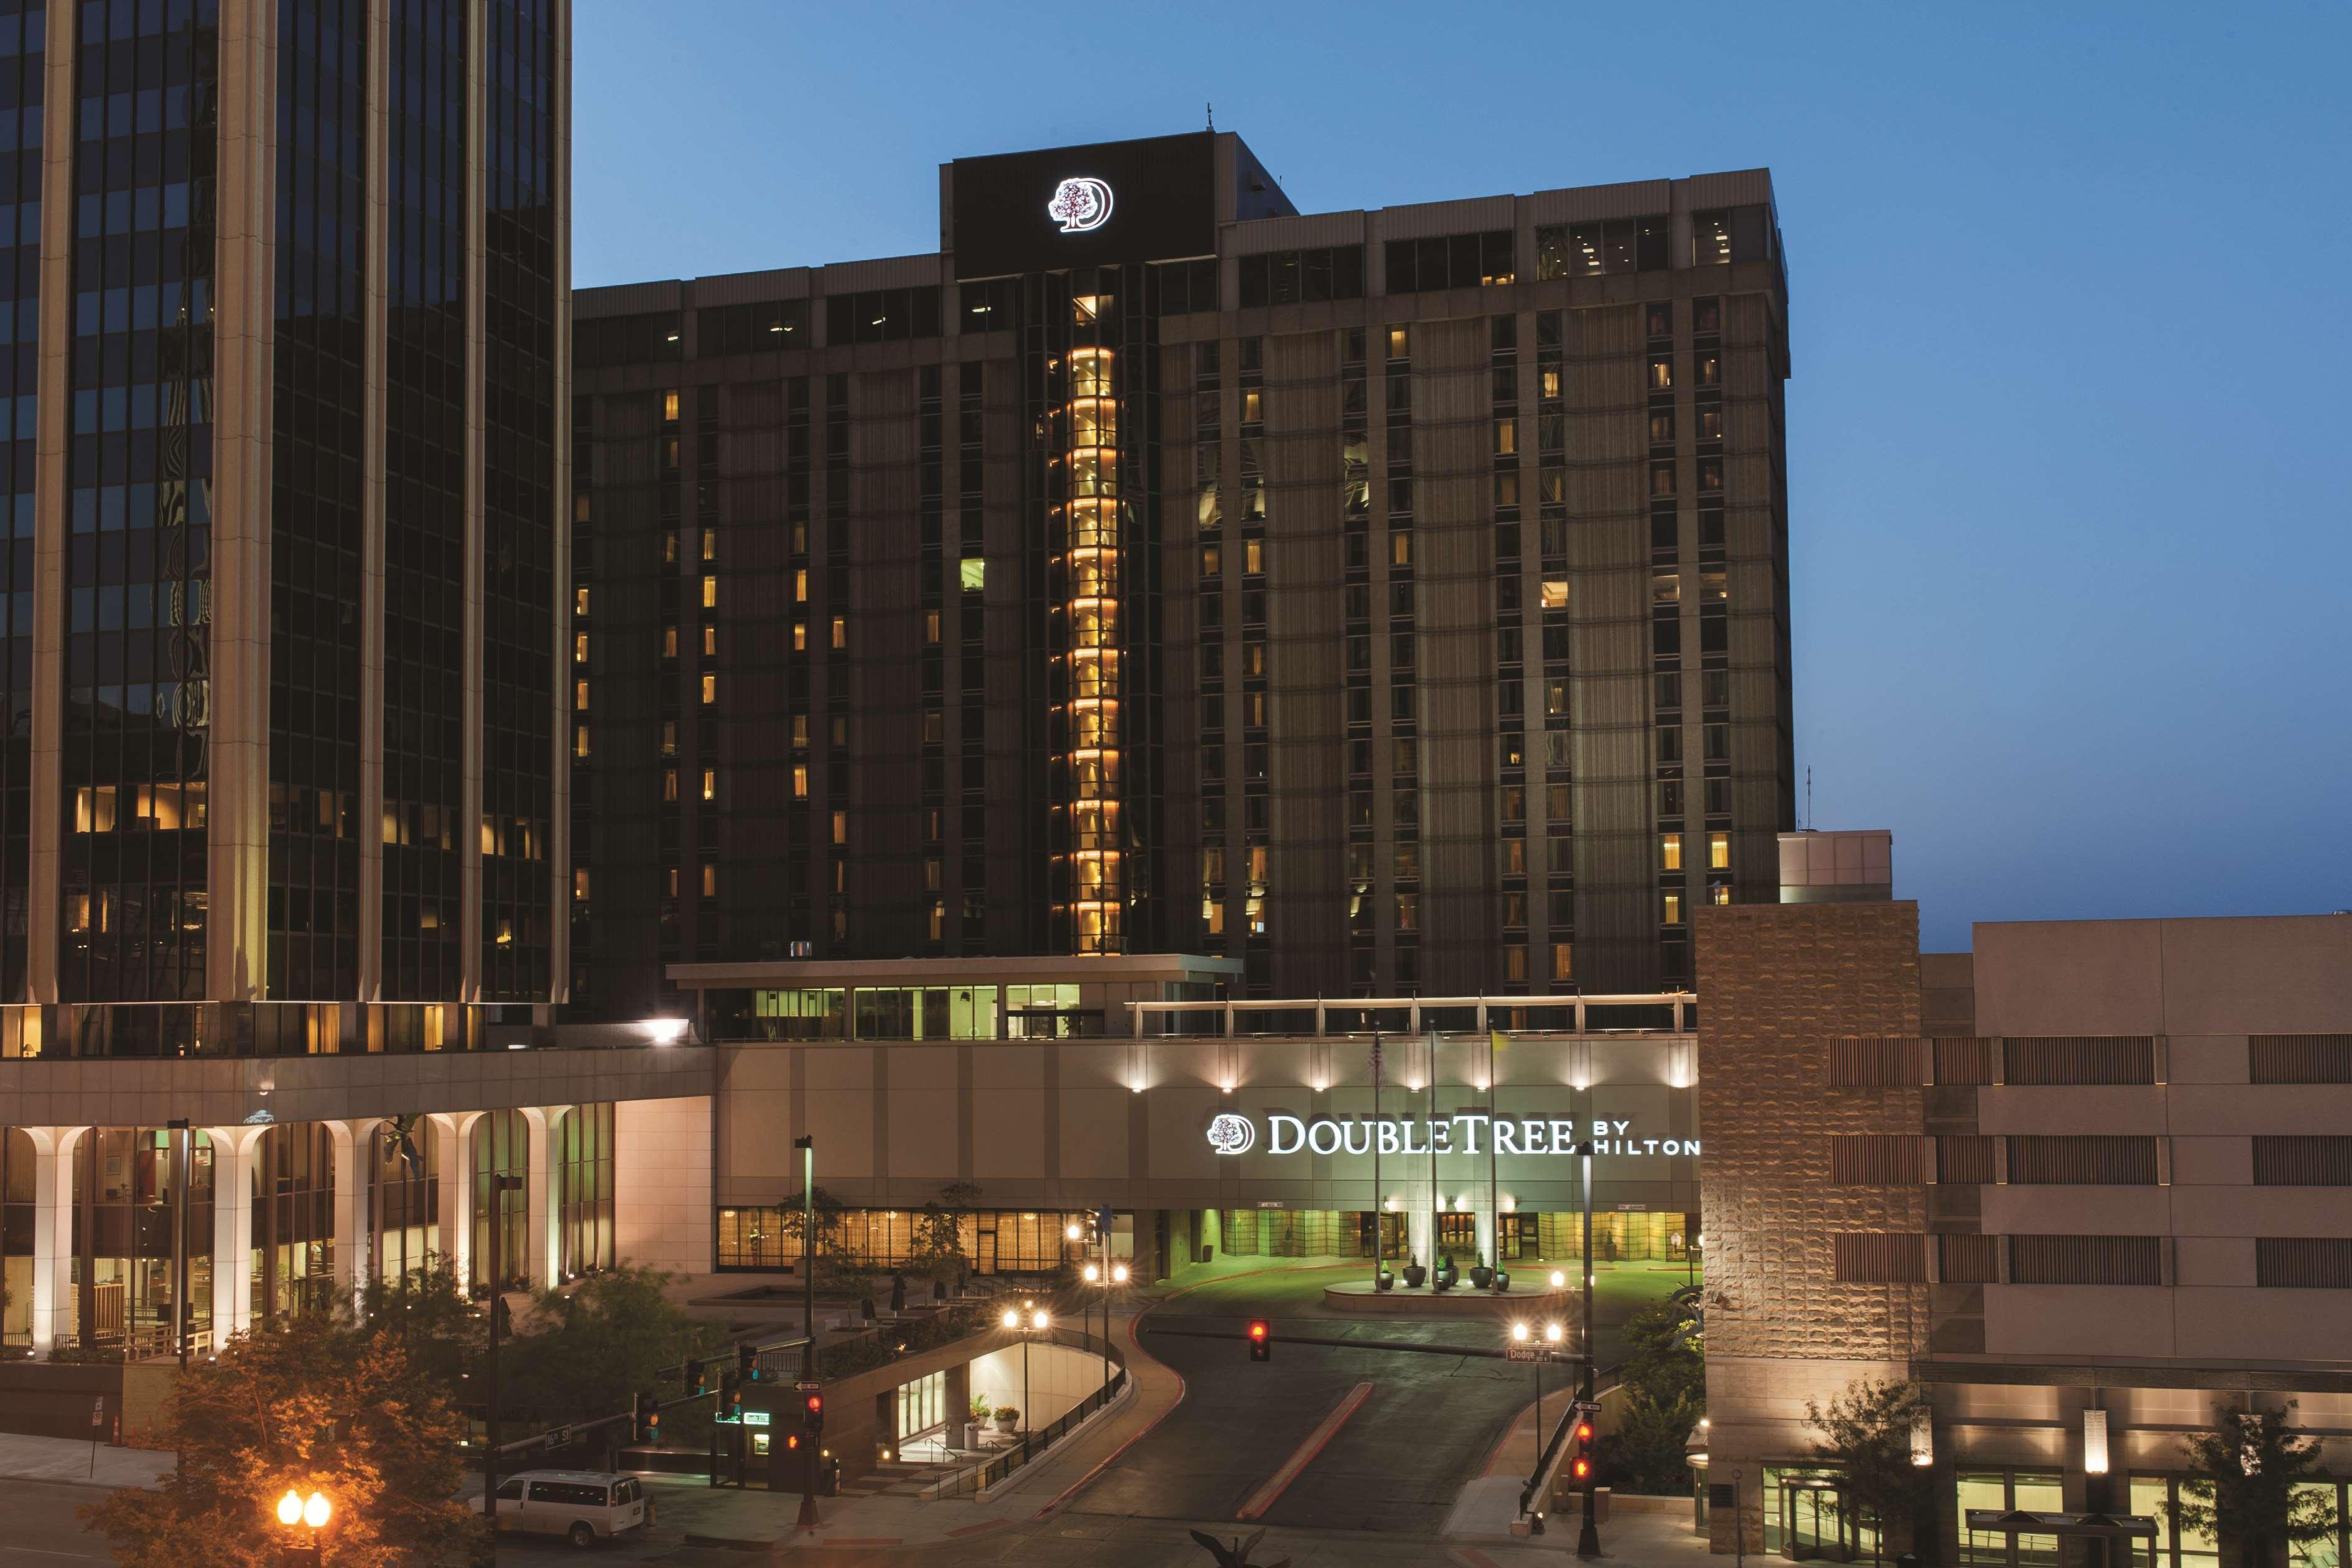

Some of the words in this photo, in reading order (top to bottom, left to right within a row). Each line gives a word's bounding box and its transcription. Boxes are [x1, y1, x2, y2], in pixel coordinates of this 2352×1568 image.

[1593, 1121, 1630, 1136] BY
[1594, 1139, 1701, 1156] HILTON
[1510, 1350, 1535, 1362] Dodge
